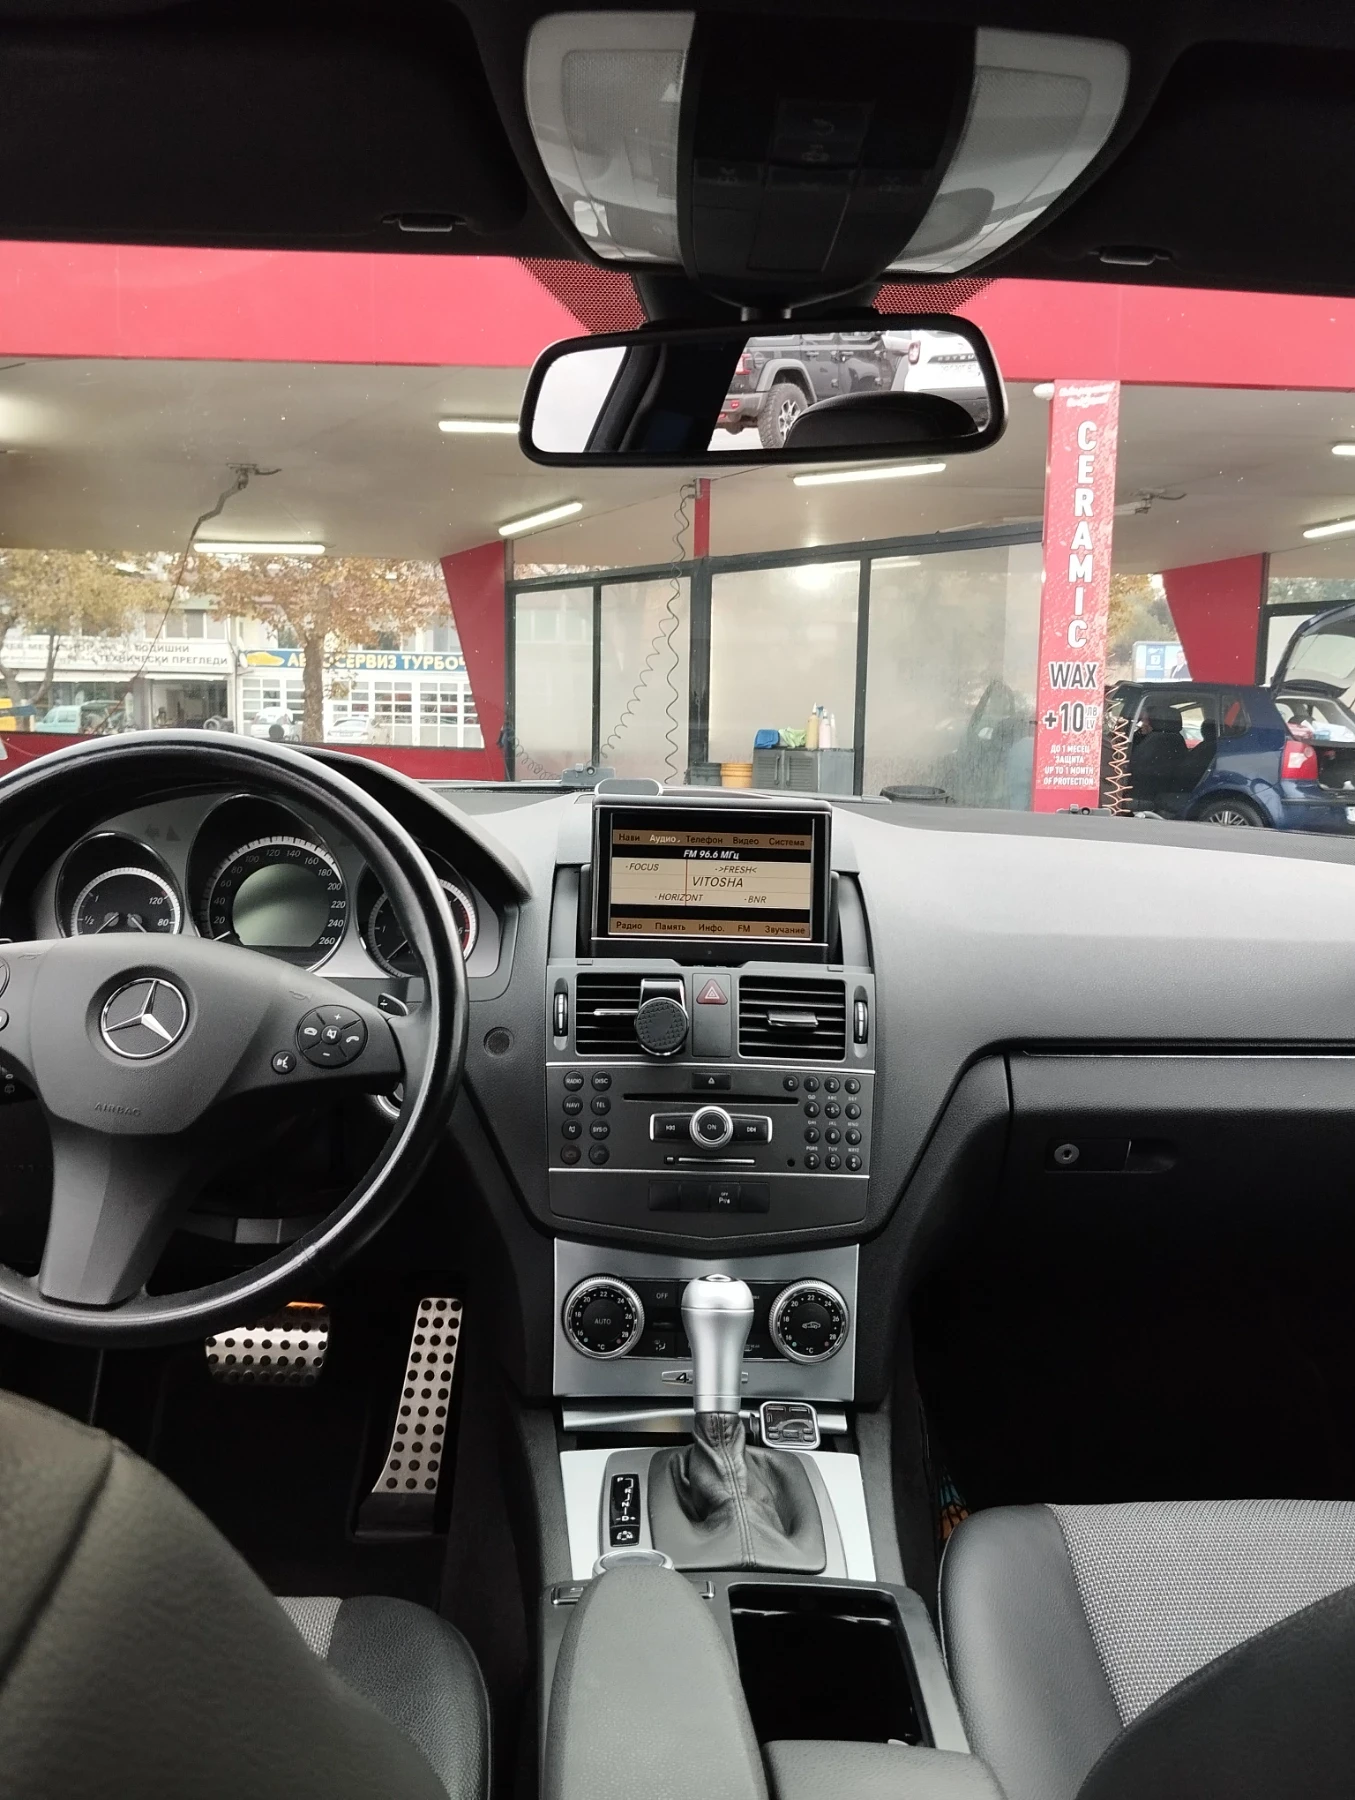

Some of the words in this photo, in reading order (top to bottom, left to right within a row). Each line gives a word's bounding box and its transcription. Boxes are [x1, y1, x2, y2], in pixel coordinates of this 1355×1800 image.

[1067, 421, 1097, 649] CERAMIC
[172, 656, 228, 665] ПРЕГЛЕДИ
[1050, 663, 1098, 688] WAX
[1043, 702, 1085, 733] +10
[1086, 719, 1095, 729] LV
[1050, 745, 1061, 754] ДО
[1045, 767, 1054, 775] UP
[1055, 767, 1064, 775] TO
[1070, 767, 1094, 775] MONTH
[1043, 777, 1052, 785] OF
[1053, 777, 1094, 785] PROTECTION
[618, 833, 641, 842] Нави
[649, 834, 677, 844] Аудио
[686, 836, 723, 845] Телефон
[733, 837, 759, 846] Видео
[768, 838, 805, 847] Система
[266, 849, 280, 857] 120
[683, 850, 697, 858] FM
[699, 850, 719, 859] 96.6
[720, 851, 739, 860] МГц
[245, 855, 259, 863] 100
[304, 857, 319, 865] 160
[231, 866, 243, 874] 80
[318, 868, 332, 876] 180
[220, 880, 231, 888] 60
[327, 882, 341, 890] 200
[692, 876, 744, 888] VITOSHA
[149, 897, 163, 905] 120
[214, 897, 225, 905] 40
[214, 916, 225, 924] 20
[327, 919, 343, 927] 240
[616, 921, 643, 930] Радио
[655, 922, 686, 932] Память
[698, 924, 725, 933] Инфо.
[737, 925, 750, 933] FM
[765, 926, 805, 935] Звучание
